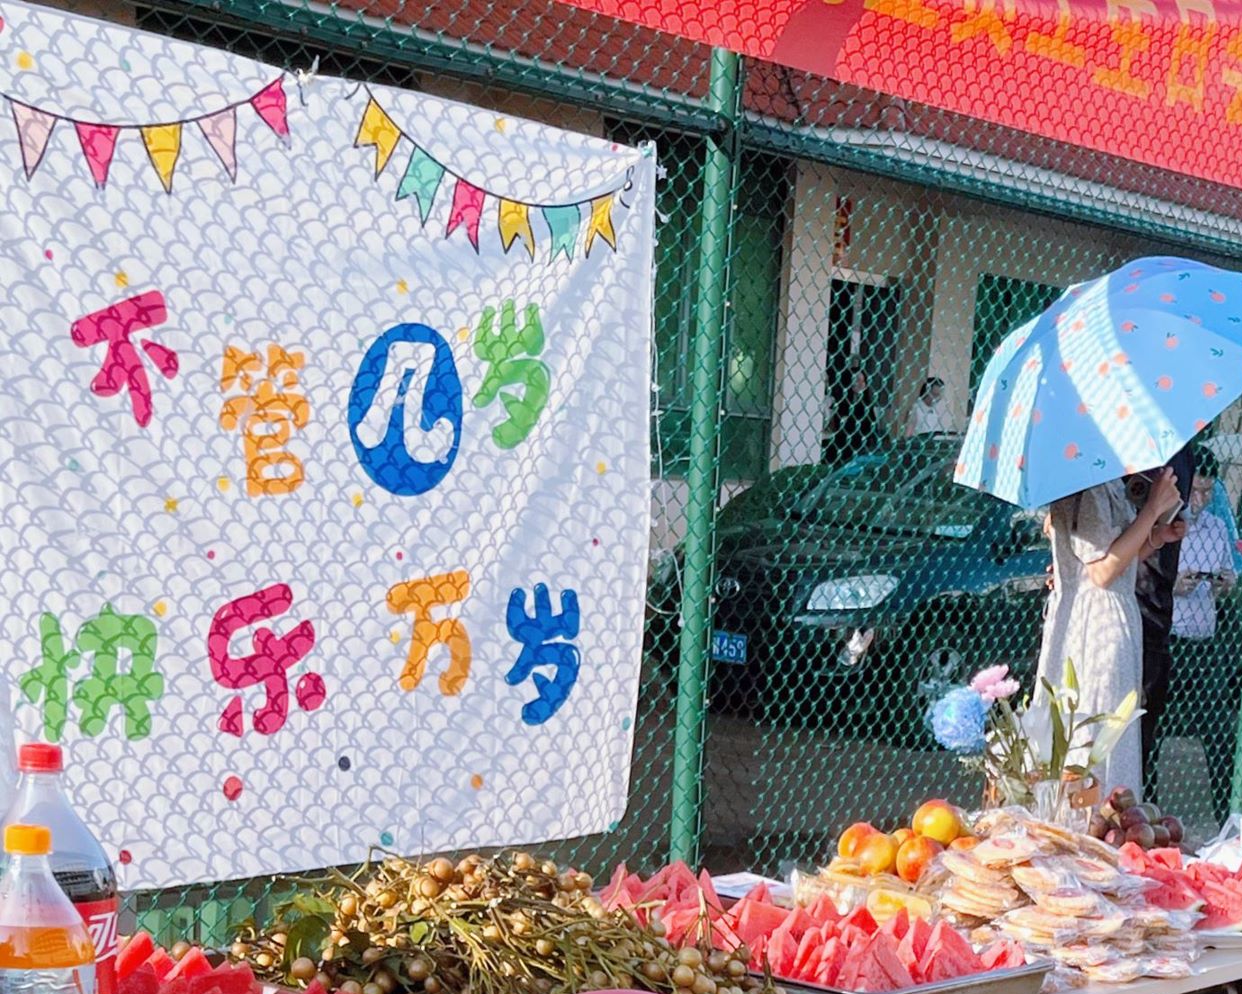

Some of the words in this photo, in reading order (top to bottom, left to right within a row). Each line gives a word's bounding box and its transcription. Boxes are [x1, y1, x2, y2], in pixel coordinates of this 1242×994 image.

[70, 290, 551, 496] 不管几岁
[19, 569, 581, 741] 快乐万岁
